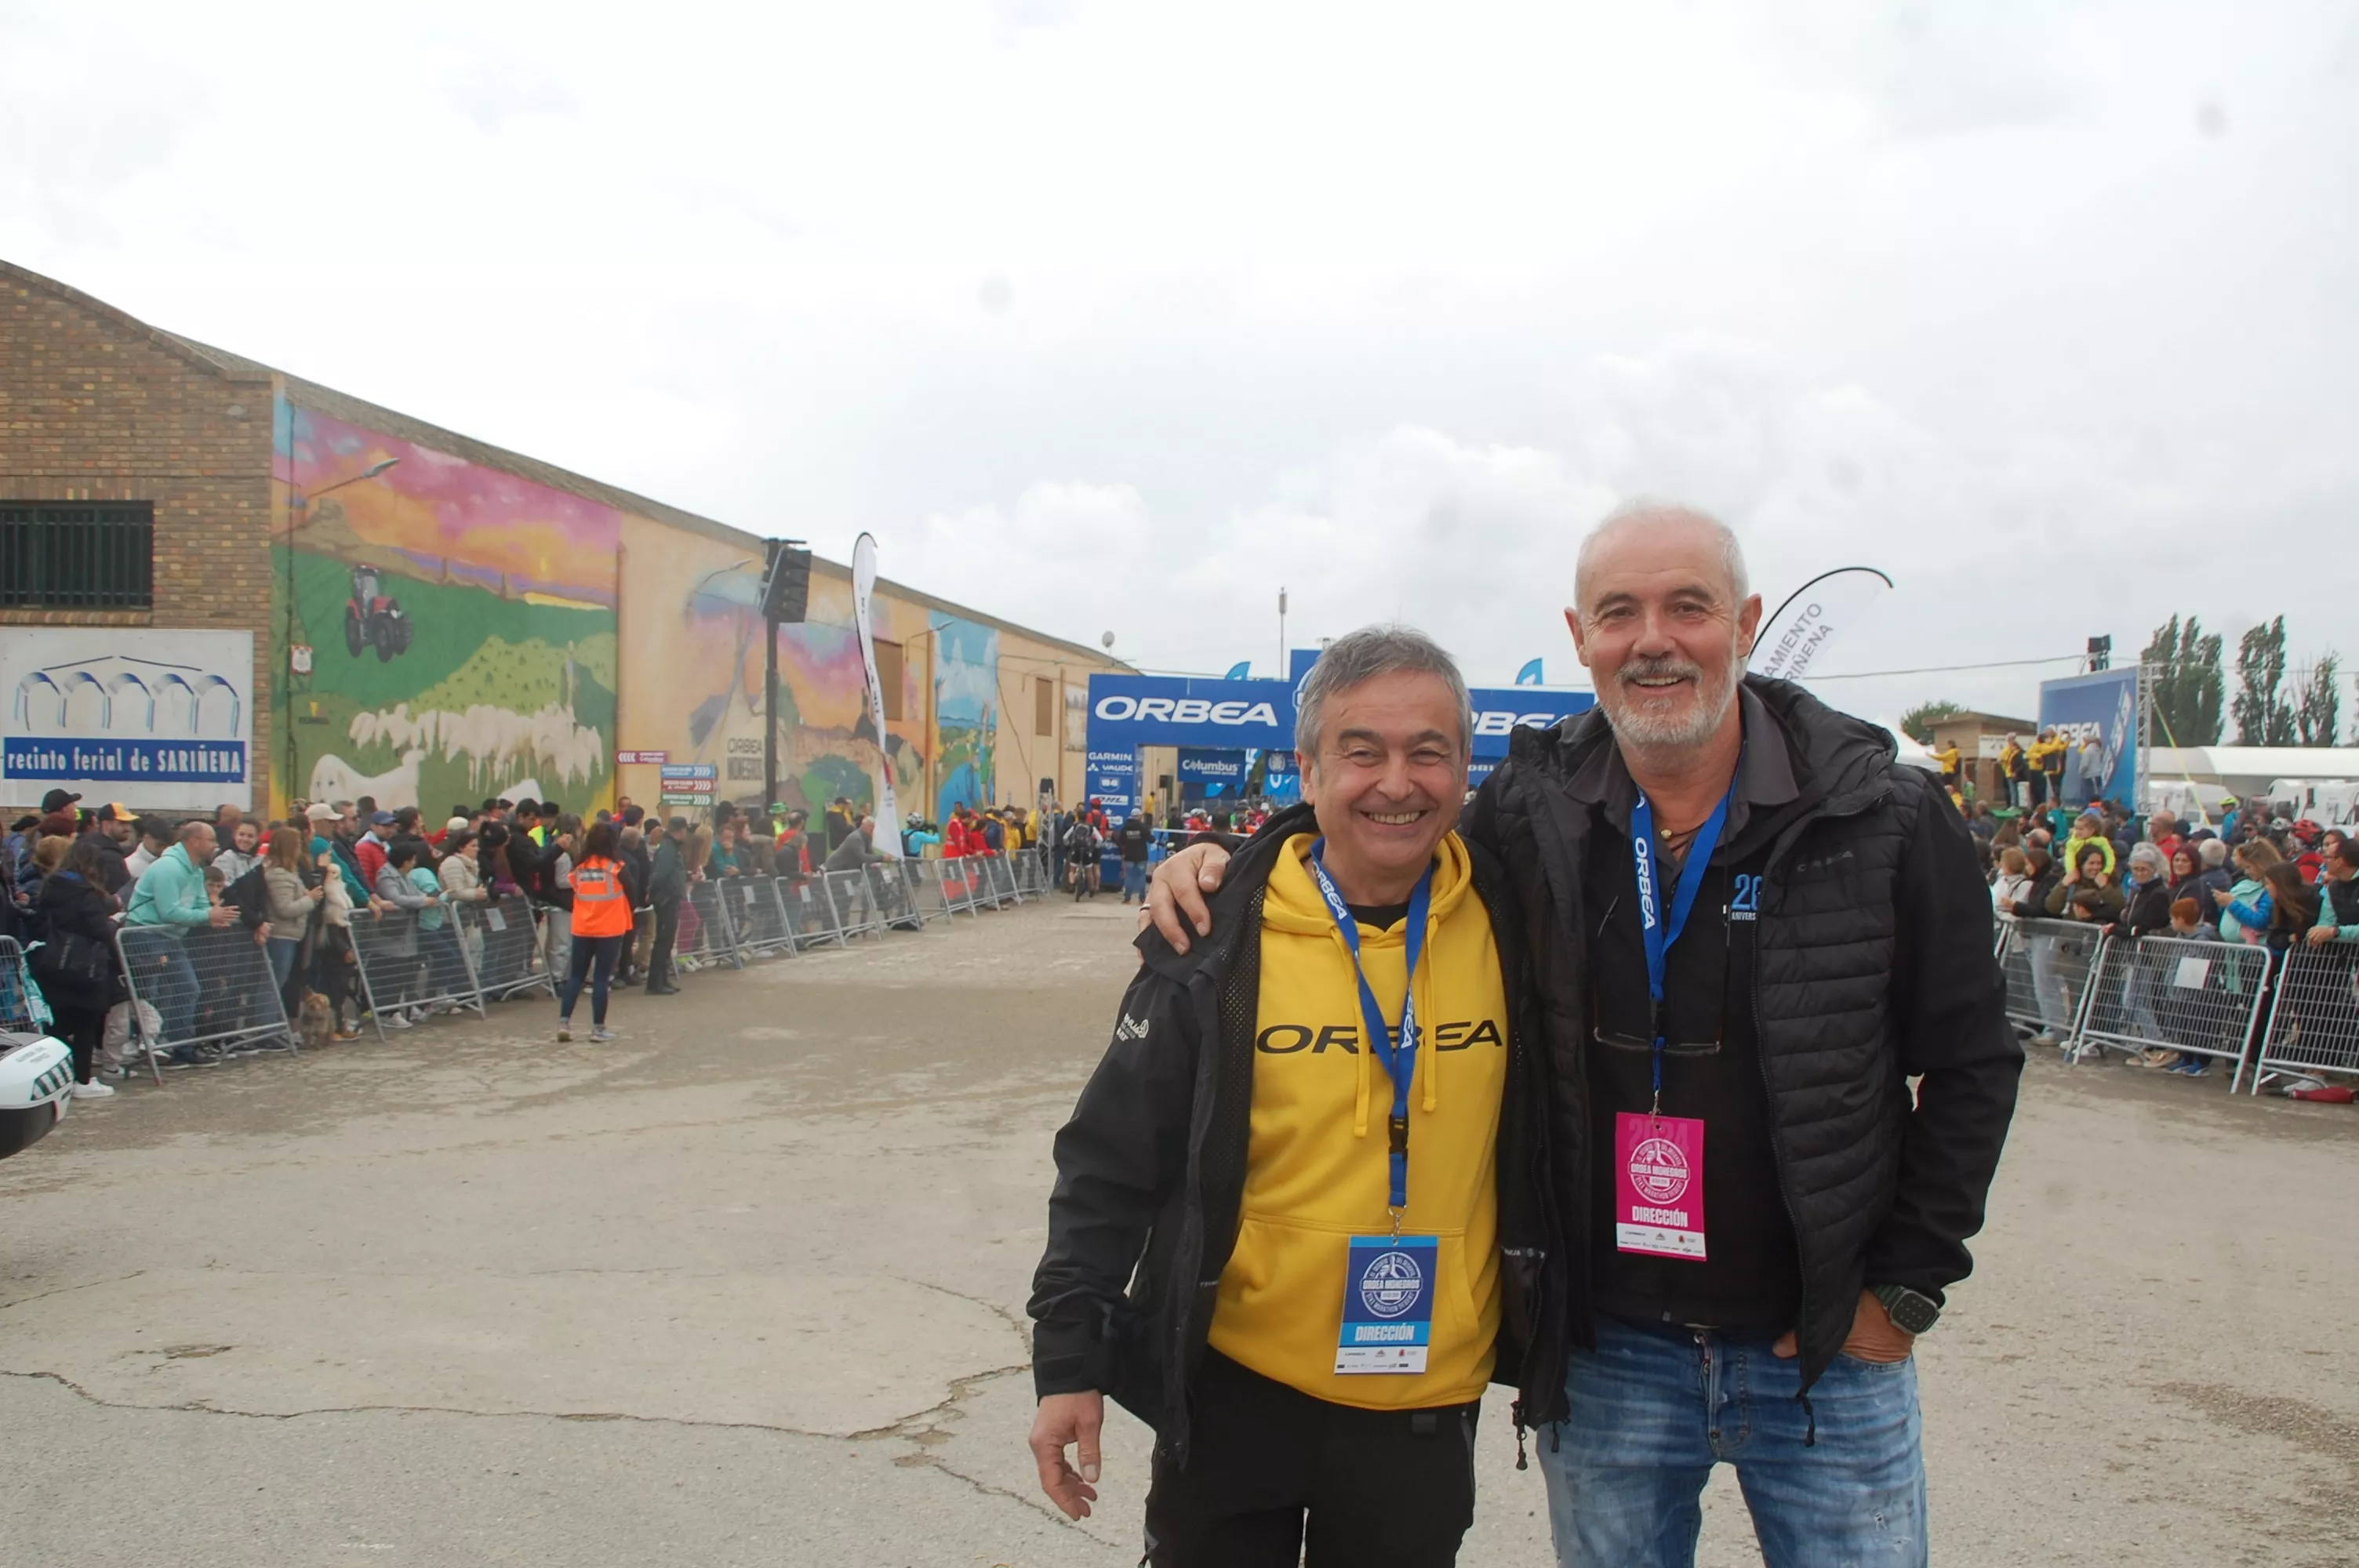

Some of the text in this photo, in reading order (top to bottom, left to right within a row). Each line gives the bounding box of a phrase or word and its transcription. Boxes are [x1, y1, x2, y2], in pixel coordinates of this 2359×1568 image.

[1764, 603, 1823, 679] AMIENTO
[1095, 695, 1278, 727] ORBEA
[728, 738, 764, 754] ORBEA
[1089, 752, 1132, 762] GARMIN
[8, 745, 241, 773] recinto ferial de SARIÑENA
[1183, 759, 1238, 772] Columbus
[1311, 861, 1348, 920] ORBEA
[1635, 837, 1656, 931] ORBEA
[1632, 1206, 1688, 1227] DIRECCIÓN
[1354, 1323, 1415, 1342] DIRECCIÓN
